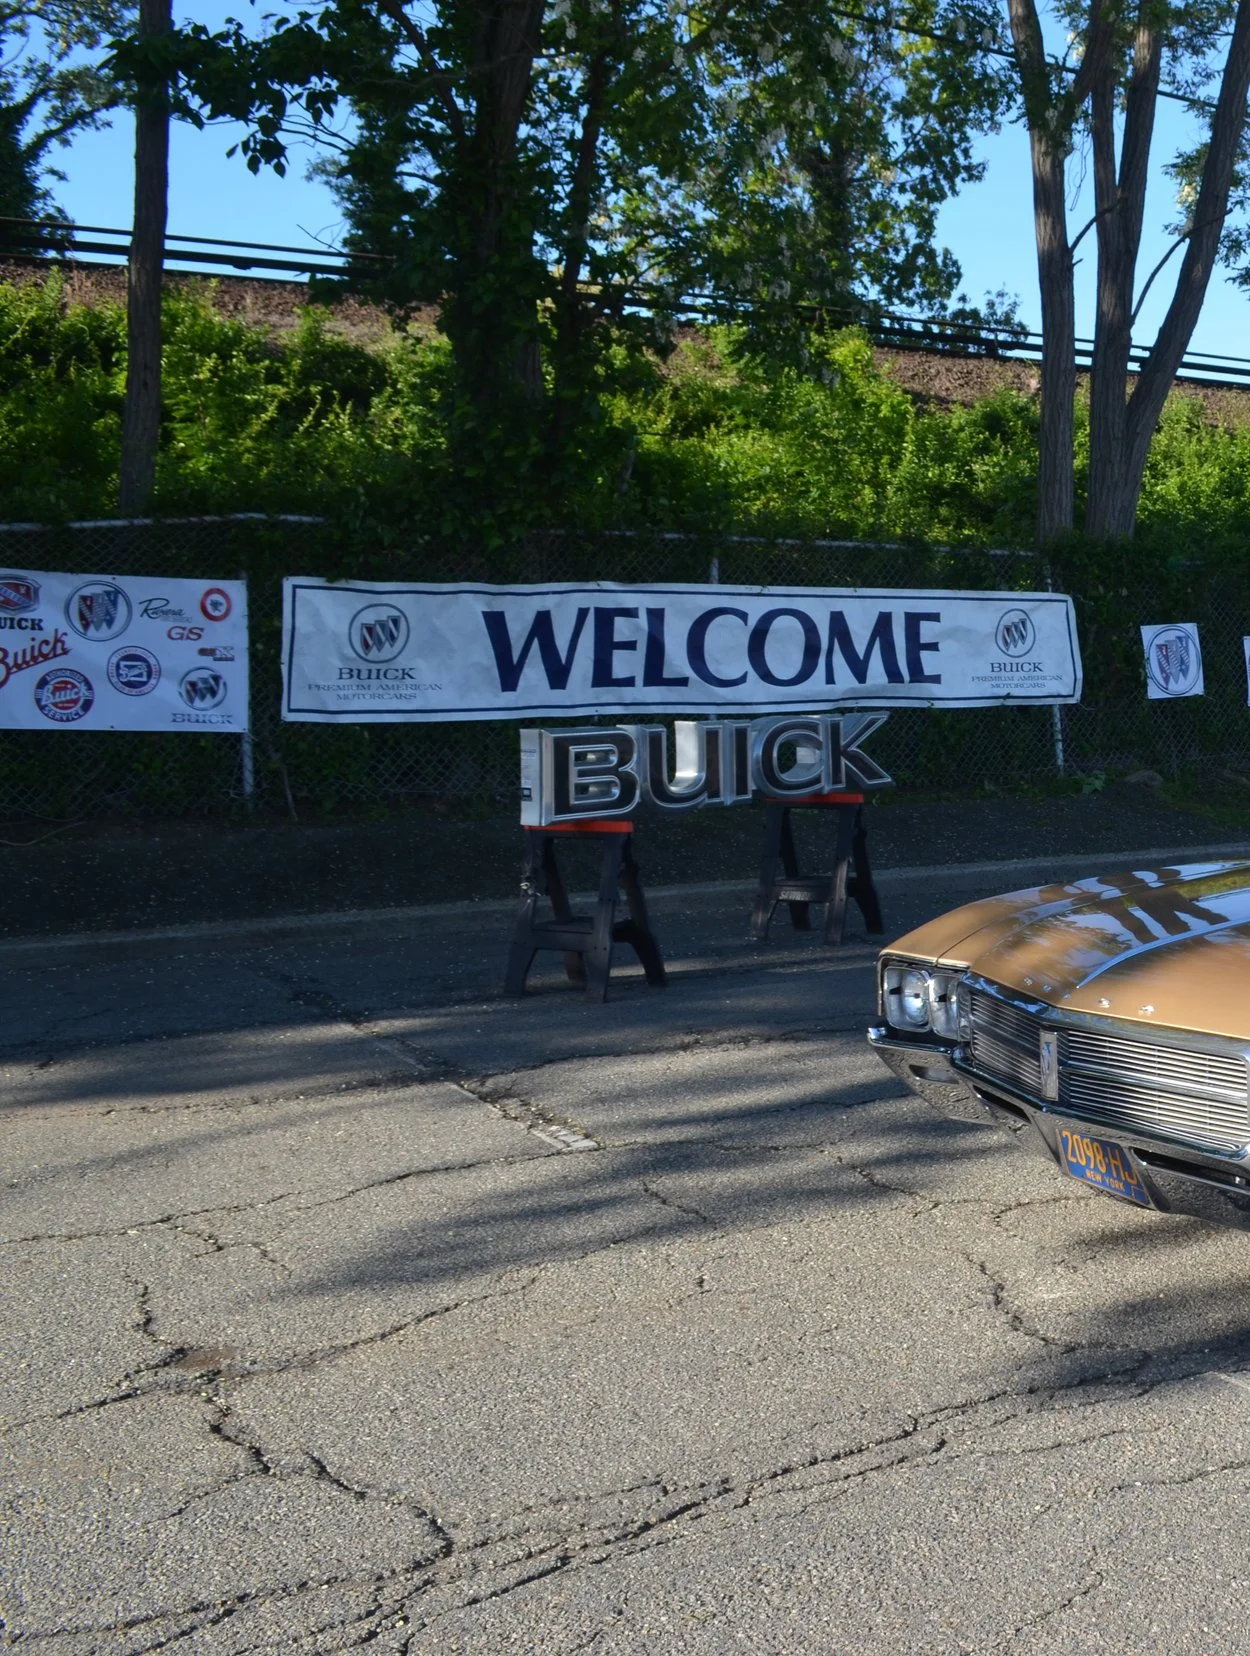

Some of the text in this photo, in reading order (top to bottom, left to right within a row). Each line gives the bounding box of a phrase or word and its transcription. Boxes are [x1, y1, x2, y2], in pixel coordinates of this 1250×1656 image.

[167, 625, 205, 641] GS
[481, 606, 942, 693] WELCOME
[337, 667, 416, 681] BUICK
[989, 661, 1044, 673] BUICK
[307, 683, 443, 692] PREMIUM AMERICAN
[336, 692, 417, 701] MOTORCARS
[42, 706, 86, 721] SERVICE
[171, 712, 233, 725] BUICK
[540, 711, 894, 825] BUICK
[1086, 1170, 1125, 1191] NEW YORK
